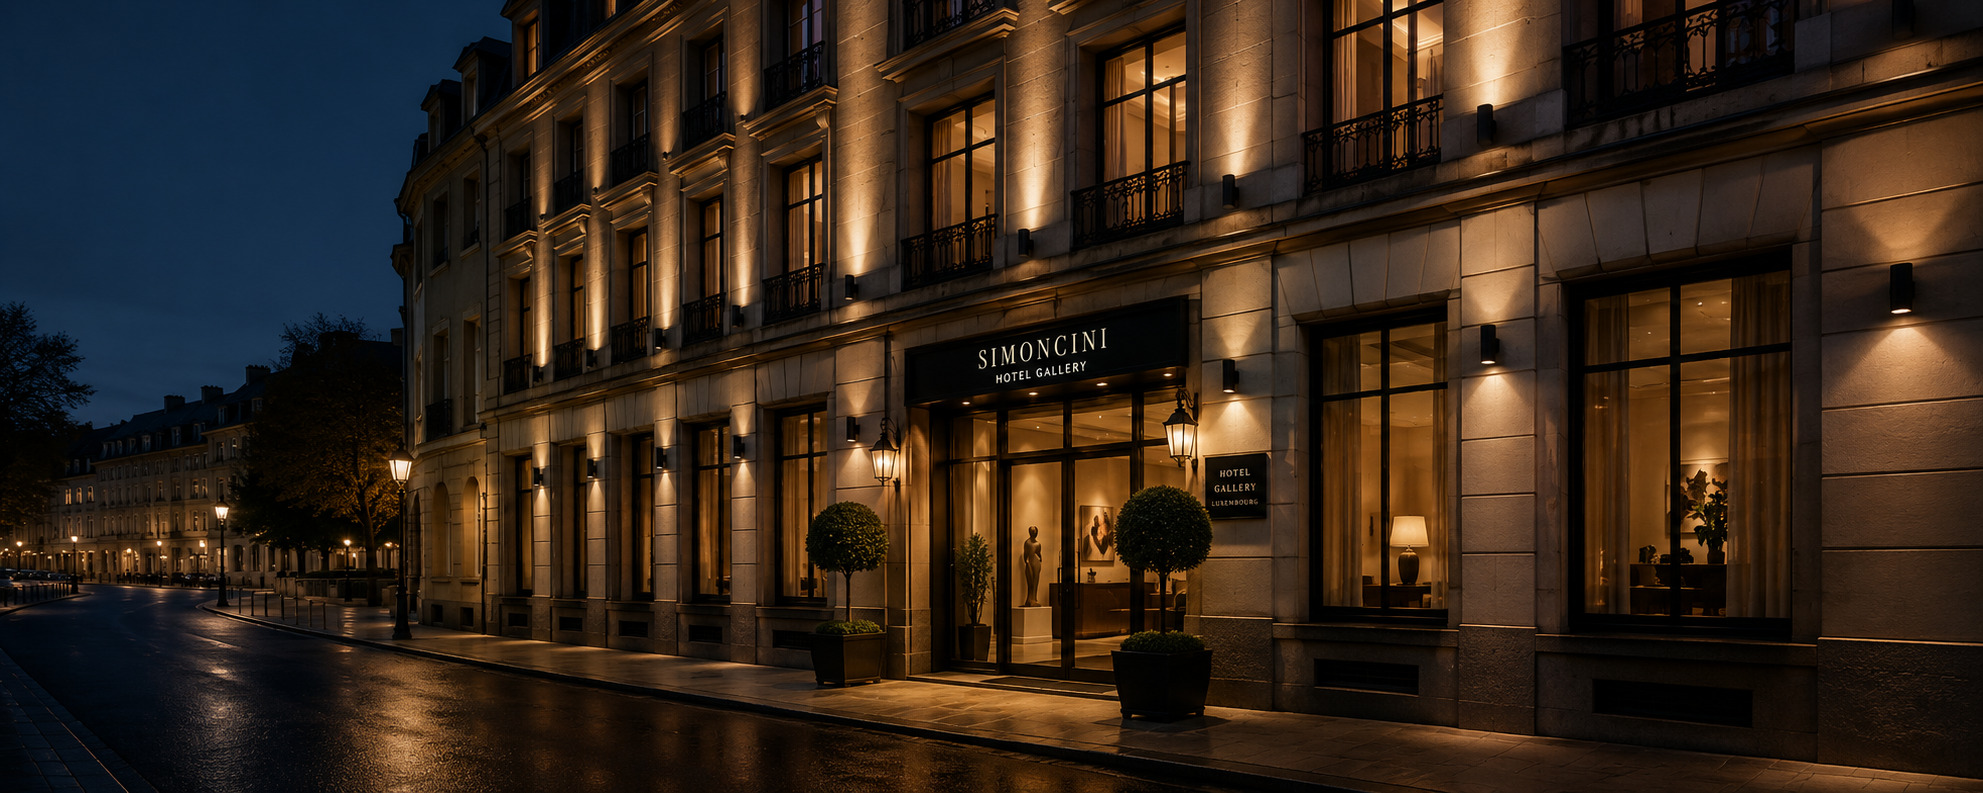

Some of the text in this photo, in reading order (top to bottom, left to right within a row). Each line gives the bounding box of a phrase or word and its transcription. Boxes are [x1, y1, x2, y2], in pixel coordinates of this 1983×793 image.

[978, 328, 1106, 369] SIMONCINI
[996, 361, 1086, 383] HOTEL GALLERY
[1220, 468, 1250, 477] HOTEL
[1214, 483, 1256, 493] GALLERY
